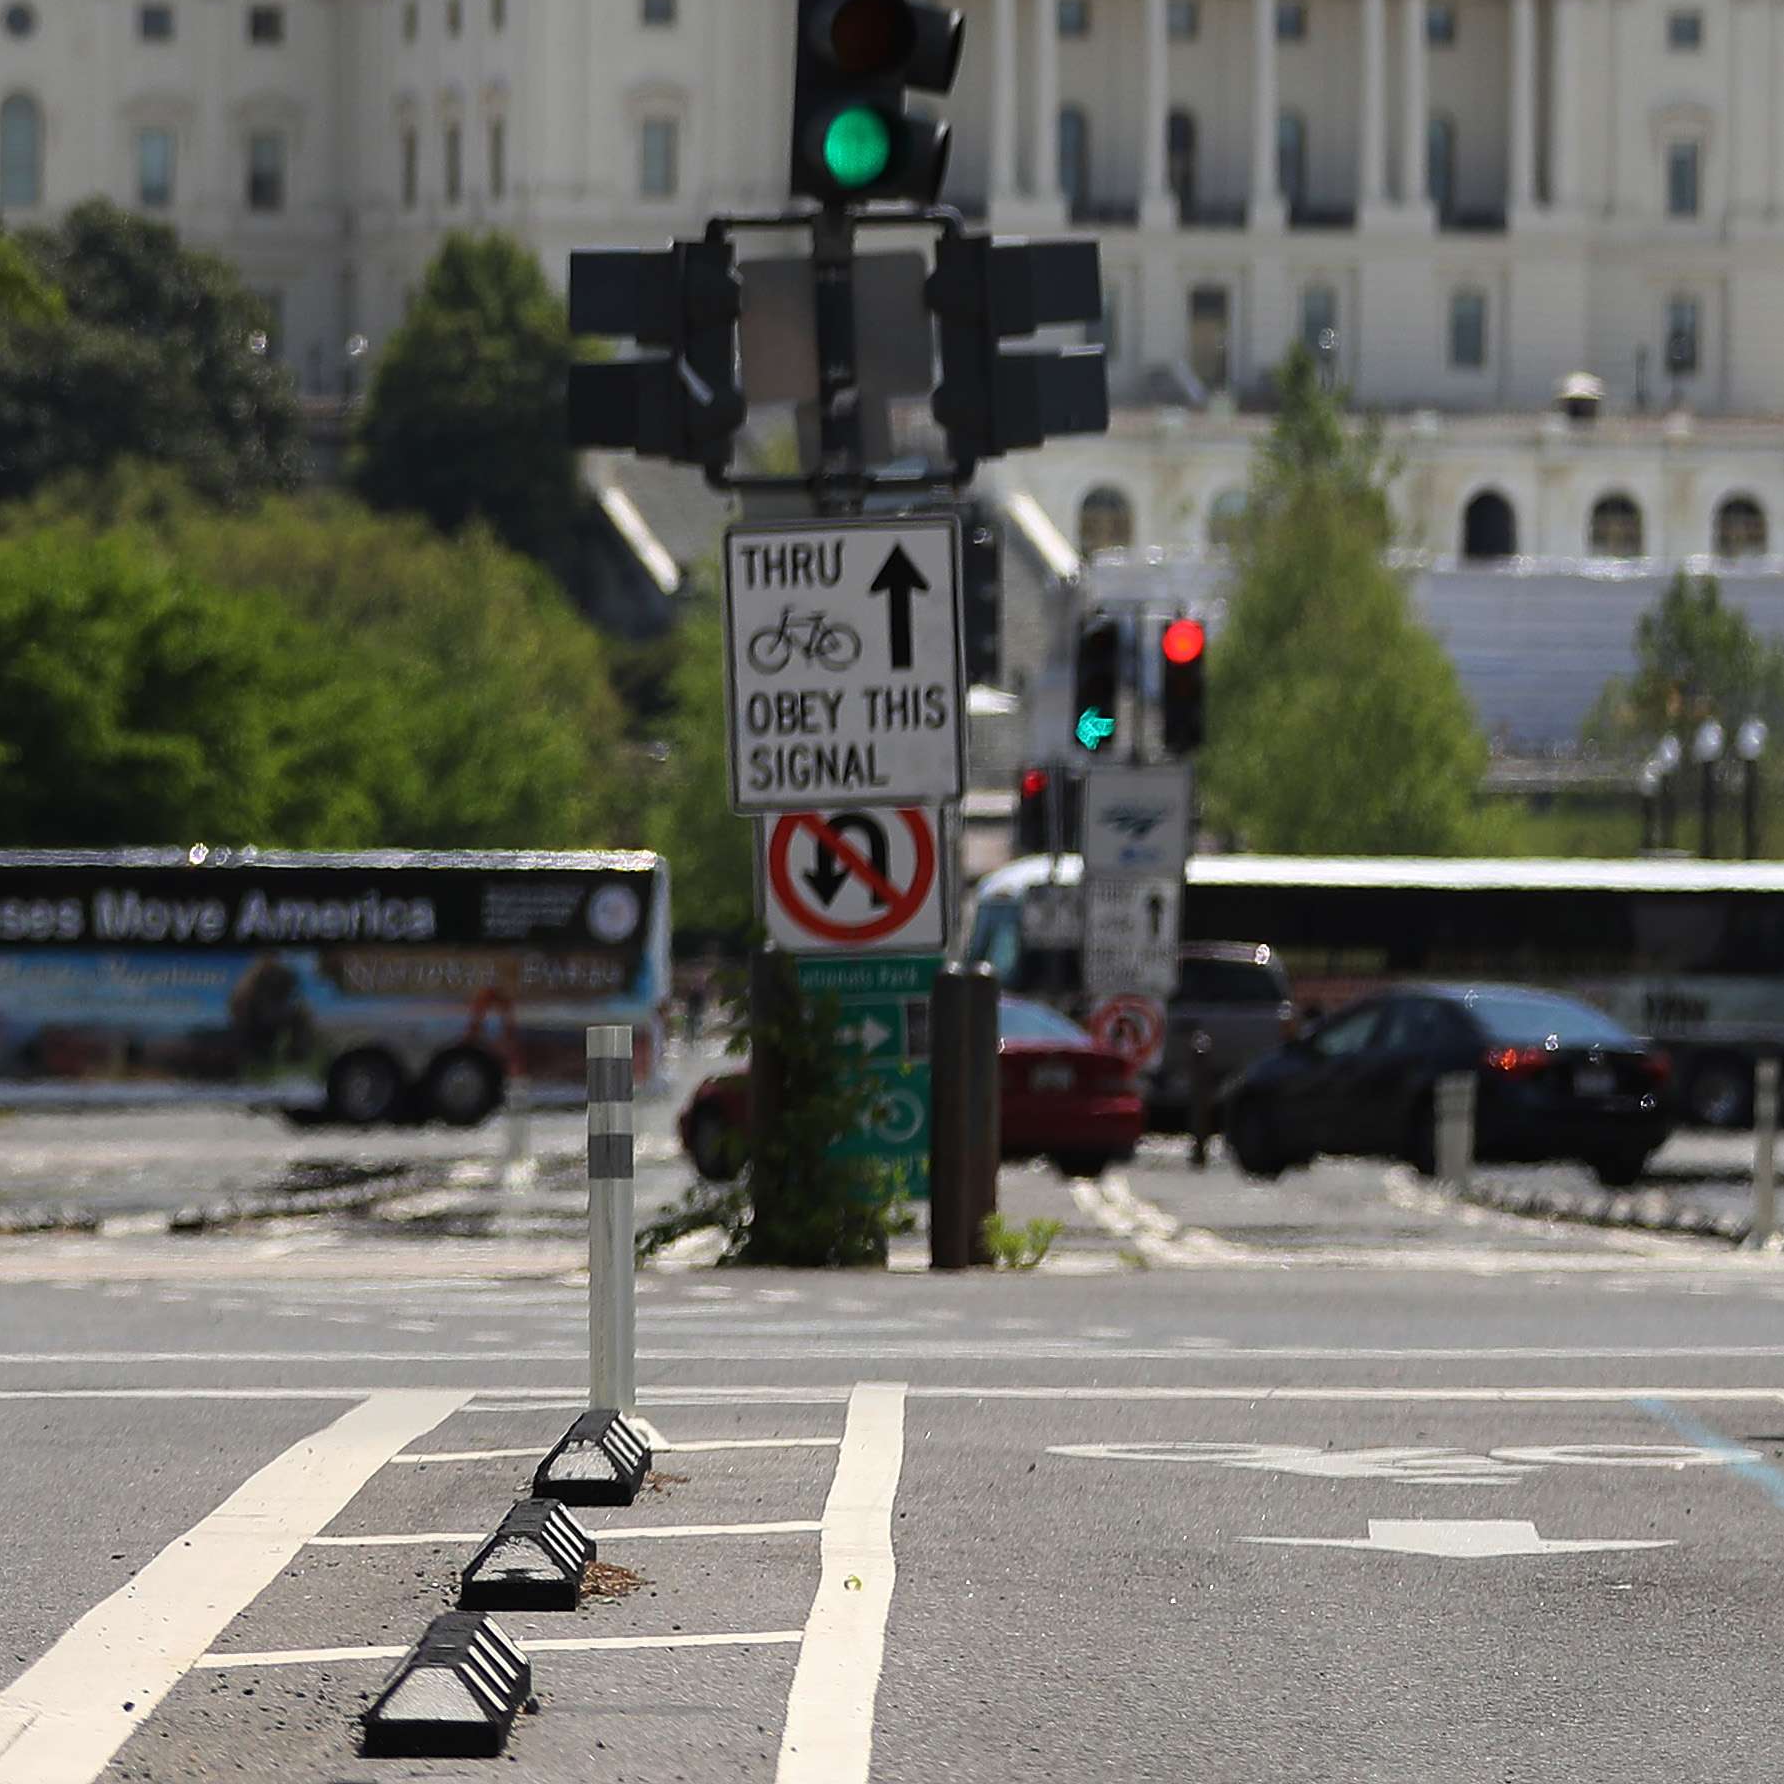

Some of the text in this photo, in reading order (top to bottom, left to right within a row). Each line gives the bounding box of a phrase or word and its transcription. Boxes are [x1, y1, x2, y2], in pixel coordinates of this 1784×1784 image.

[739, 538, 845, 590] THRU
[746, 684, 946, 737] OBEY THIS
[747, 742, 890, 792] SIGNAL
[92, 887, 227, 942] Move
[234, 887, 438, 942] America
